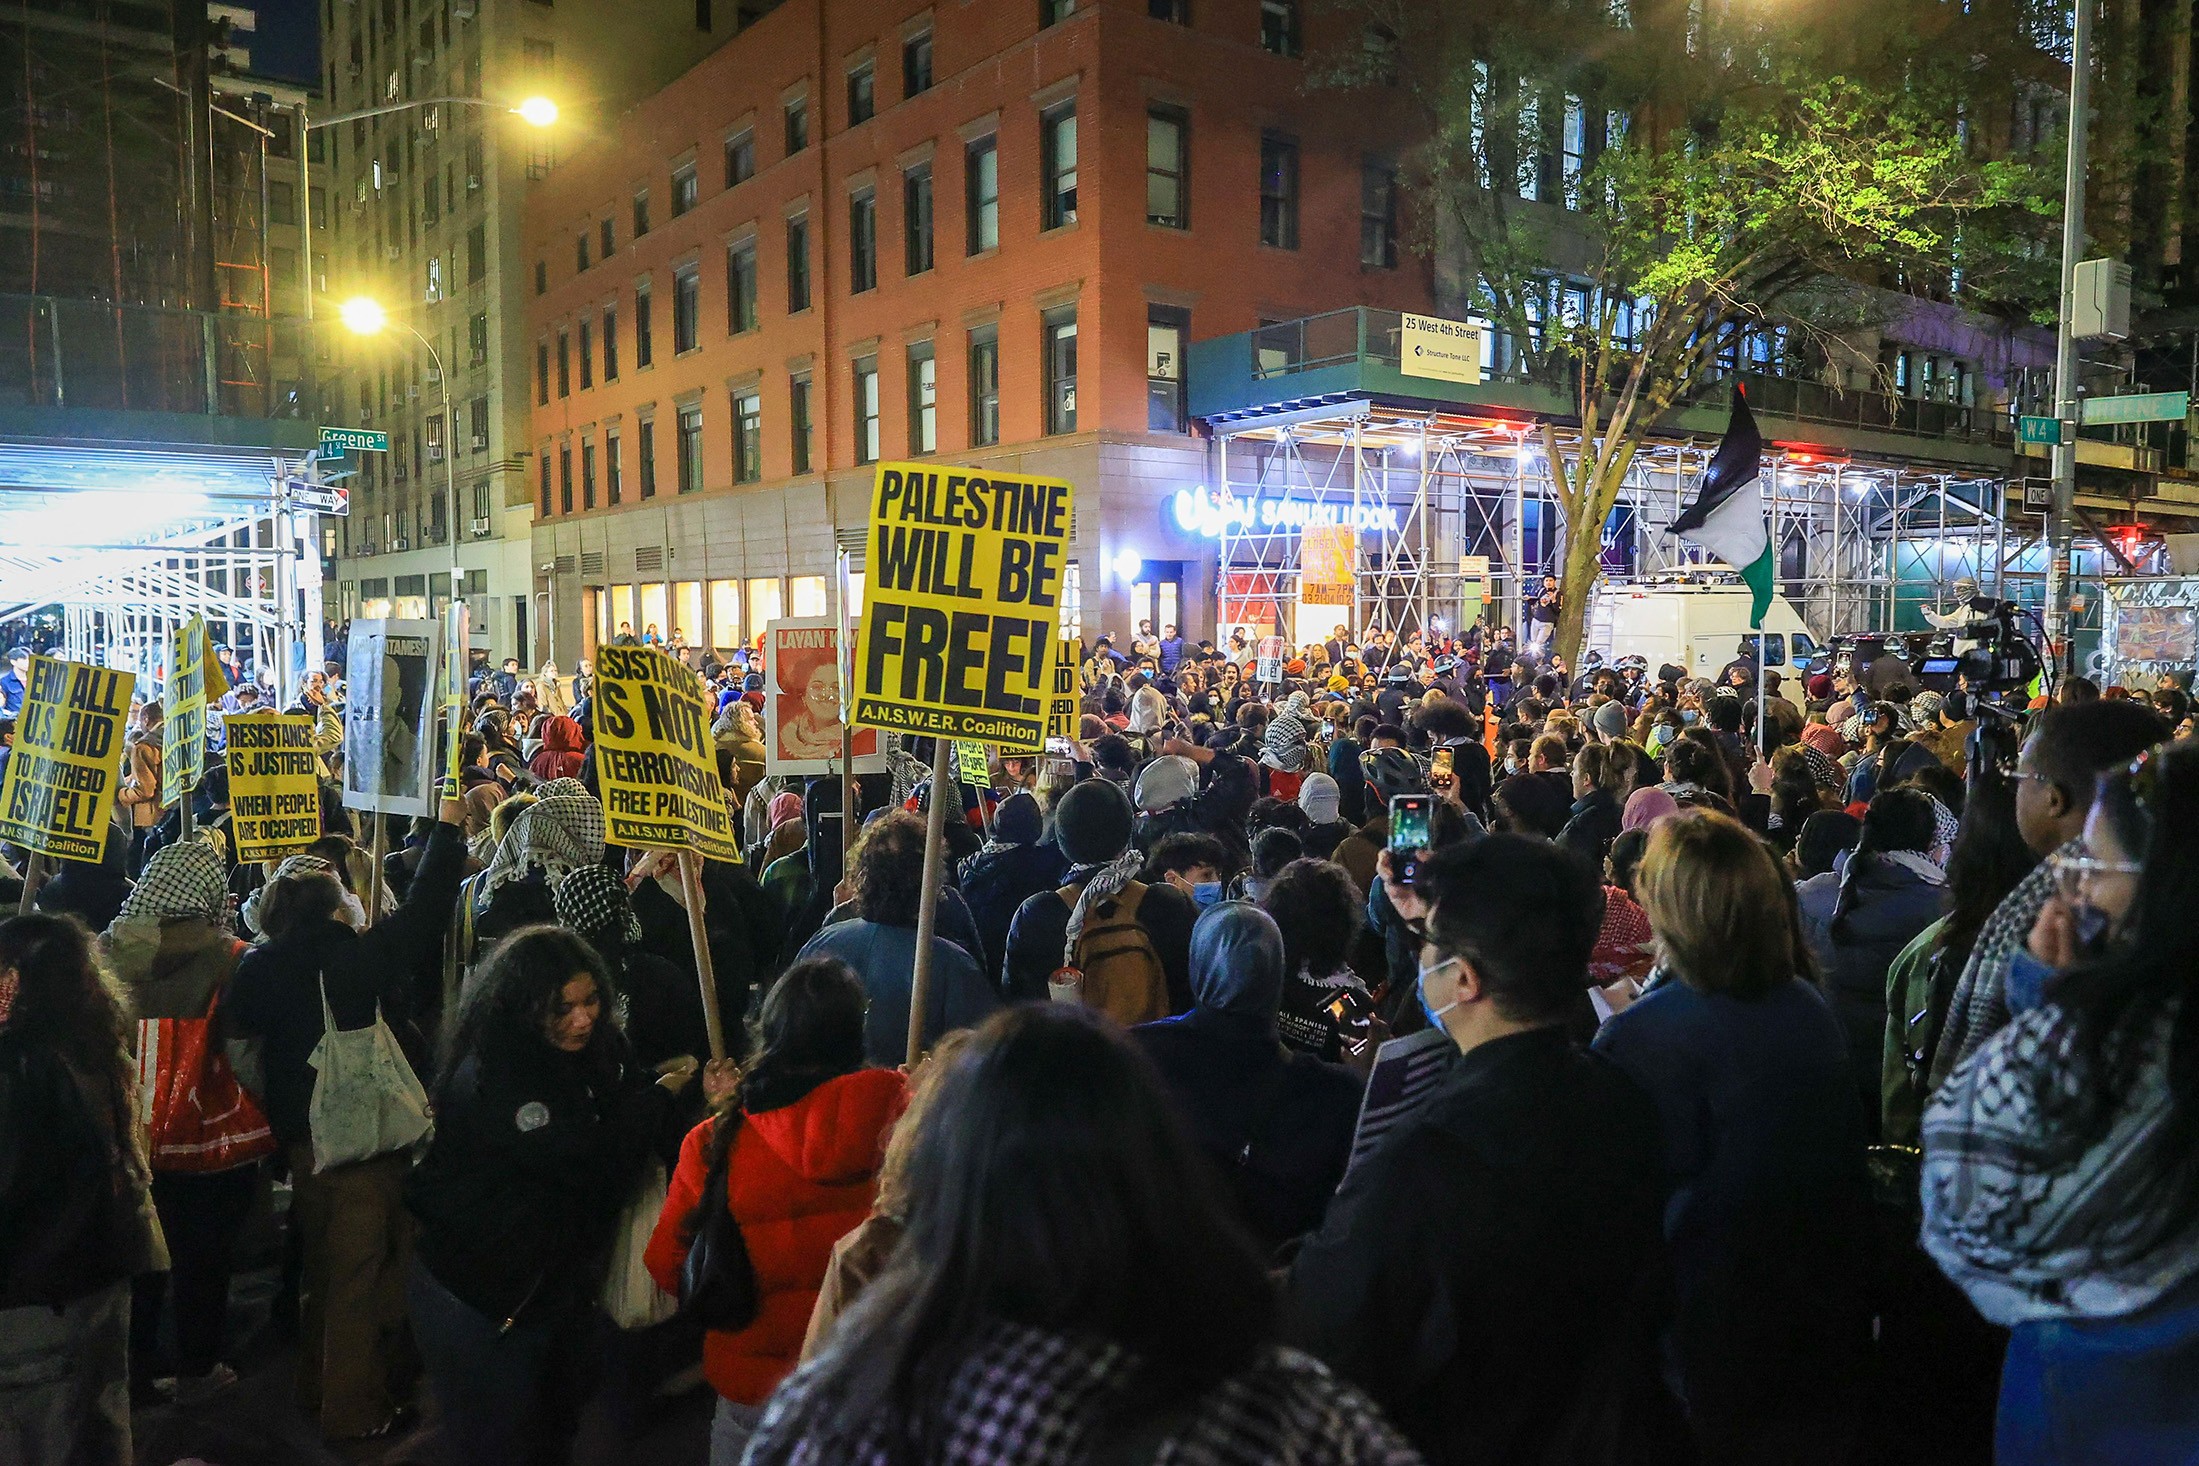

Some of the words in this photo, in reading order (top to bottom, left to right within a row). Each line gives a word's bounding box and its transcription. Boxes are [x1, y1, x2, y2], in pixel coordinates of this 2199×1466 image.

[1406, 318, 1416, 329] 25
[1419, 319, 1438, 333] West
[1440, 323, 1453, 335] 4th
[1455, 326, 1478, 340] Street
[1426, 349, 1449, 359] Structure
[322, 430, 375, 448] Greene
[377, 434, 385, 442] St
[2026, 420, 2037, 439] W
[2039, 421, 2047, 439] 4
[327, 443, 333, 456] 4
[292, 490, 310, 502] ONE
[320, 494, 340, 506] WAY
[878, 470, 1067, 537] PALESTINE
[2031, 489, 2046, 503] ONE
[1302, 539, 1337, 551] CLOSED
[878, 524, 982, 599] WILL
[997, 538, 1058, 607] BE
[779, 631, 825, 649] LAYAN
[1260, 646, 1280, 658] NOW
[865, 602, 1049, 715] FREE!
[596, 646, 704, 703] ESISTANCE
[30, 659, 69, 705] END
[69, 668, 120, 716] ALL
[596, 677, 635, 739] IS
[641, 684, 706, 759] NOT
[862, 706, 957, 731] A.N.S.W.E.R.
[962, 717, 1037, 741] Coalition
[24, 703, 56, 750] U.S.
[61, 711, 114, 759] AID
[229, 723, 313, 748] RESISTANCE
[15, 752, 33, 777] TO
[32, 757, 107, 793] APARTHEID
[230, 752, 244, 776] IS
[248, 752, 314, 776] JUSTIFIED
[600, 745, 722, 805] TERRORISM!
[8, 779, 99, 837] ISRAEL!
[233, 795, 272, 817] WHEN
[275, 793, 316, 815] PEOPLE
[609, 788, 651, 816] FREE
[655, 793, 727, 834] PALESTINE!
[237, 821, 258, 840] ARE
[260, 818, 318, 840] OCCUPIED!
[618, 823, 691, 842] A.N.S.W.E.R.
[691, 834, 734, 856] Coalition
[43, 837, 95, 856] Coalition
[1294, 1016, 1328, 1031] SPANISH
